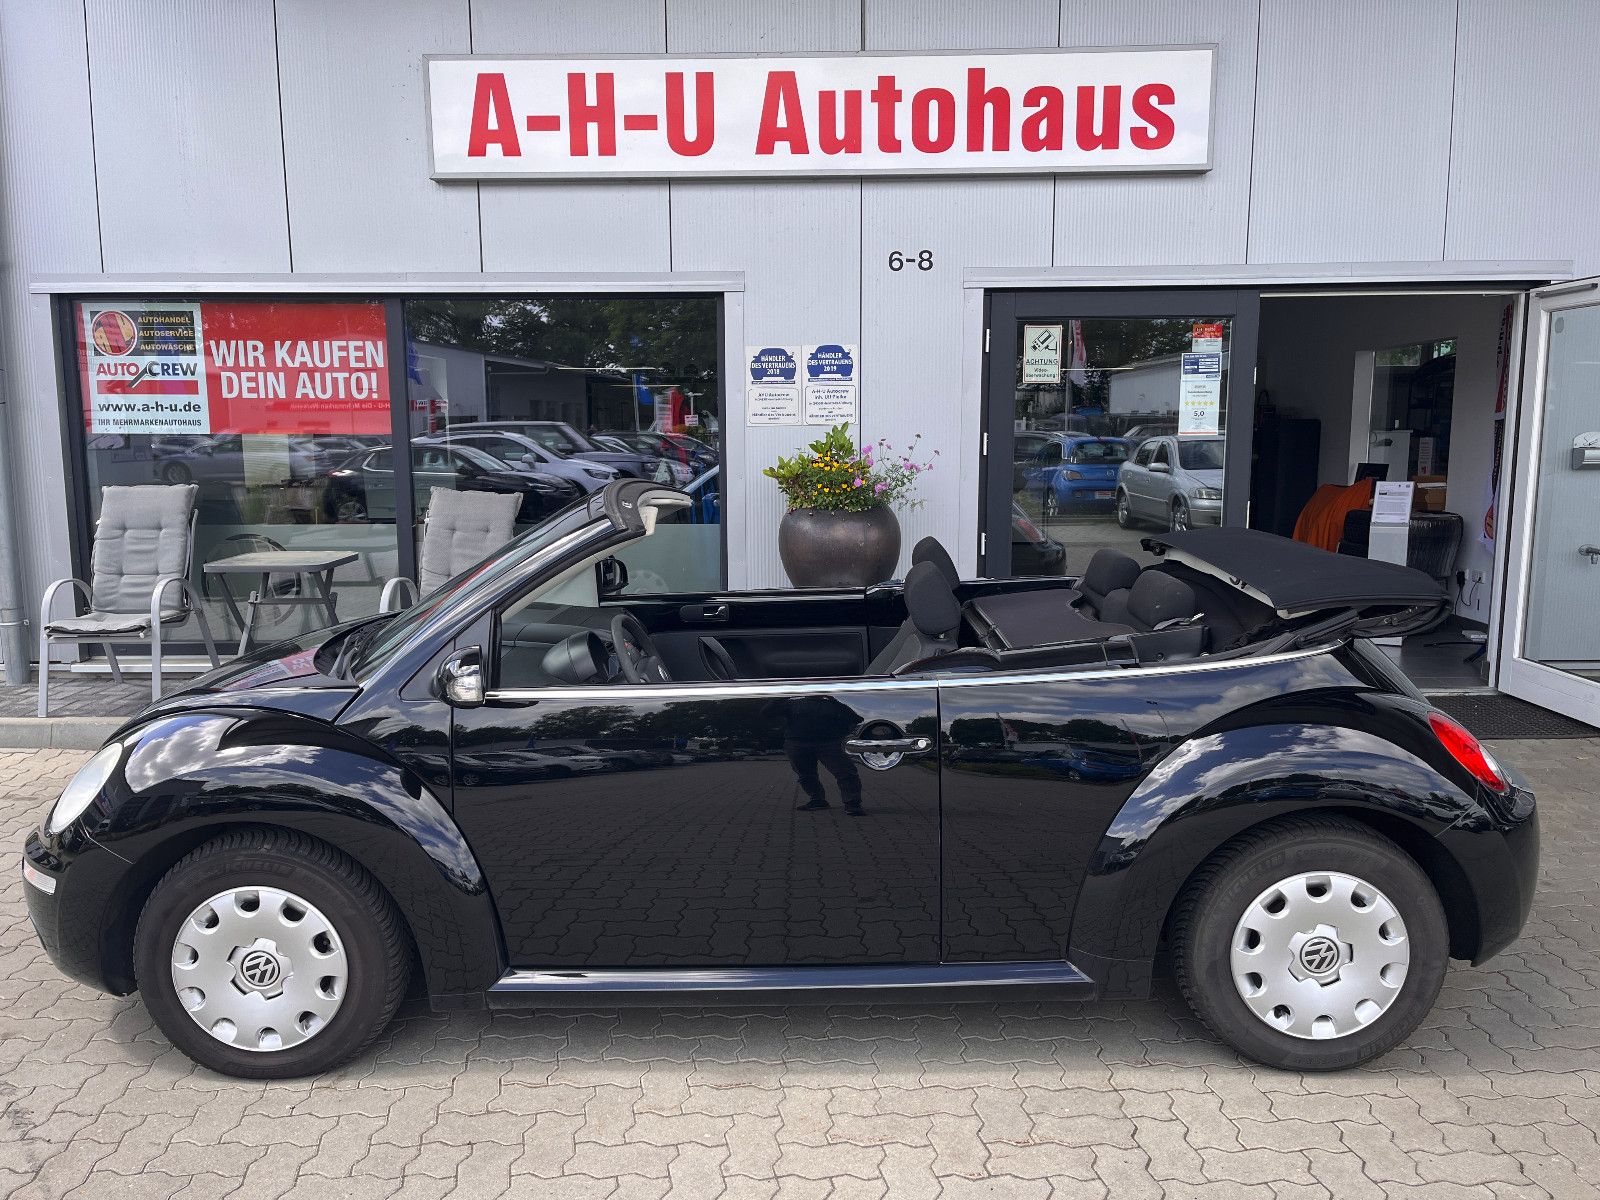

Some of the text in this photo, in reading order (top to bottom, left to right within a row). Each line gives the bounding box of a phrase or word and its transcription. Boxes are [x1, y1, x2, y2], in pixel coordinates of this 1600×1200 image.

[469, 68, 1175, 157] A-H-U Autohaus
[889, 250, 934, 271] 6-8
[210, 341, 385, 368] WIR KAUFEN
[761, 354, 786, 362] HÄNDLER
[817, 351, 842, 359] HÄNDLER
[96, 361, 198, 377] AUTO CREW
[221, 371, 378, 399] DEIN AUTO!
[98, 401, 202, 412] www.a-h-u.de
[112, 419, 202, 427] MEHRMARKENAUTOHAUS
